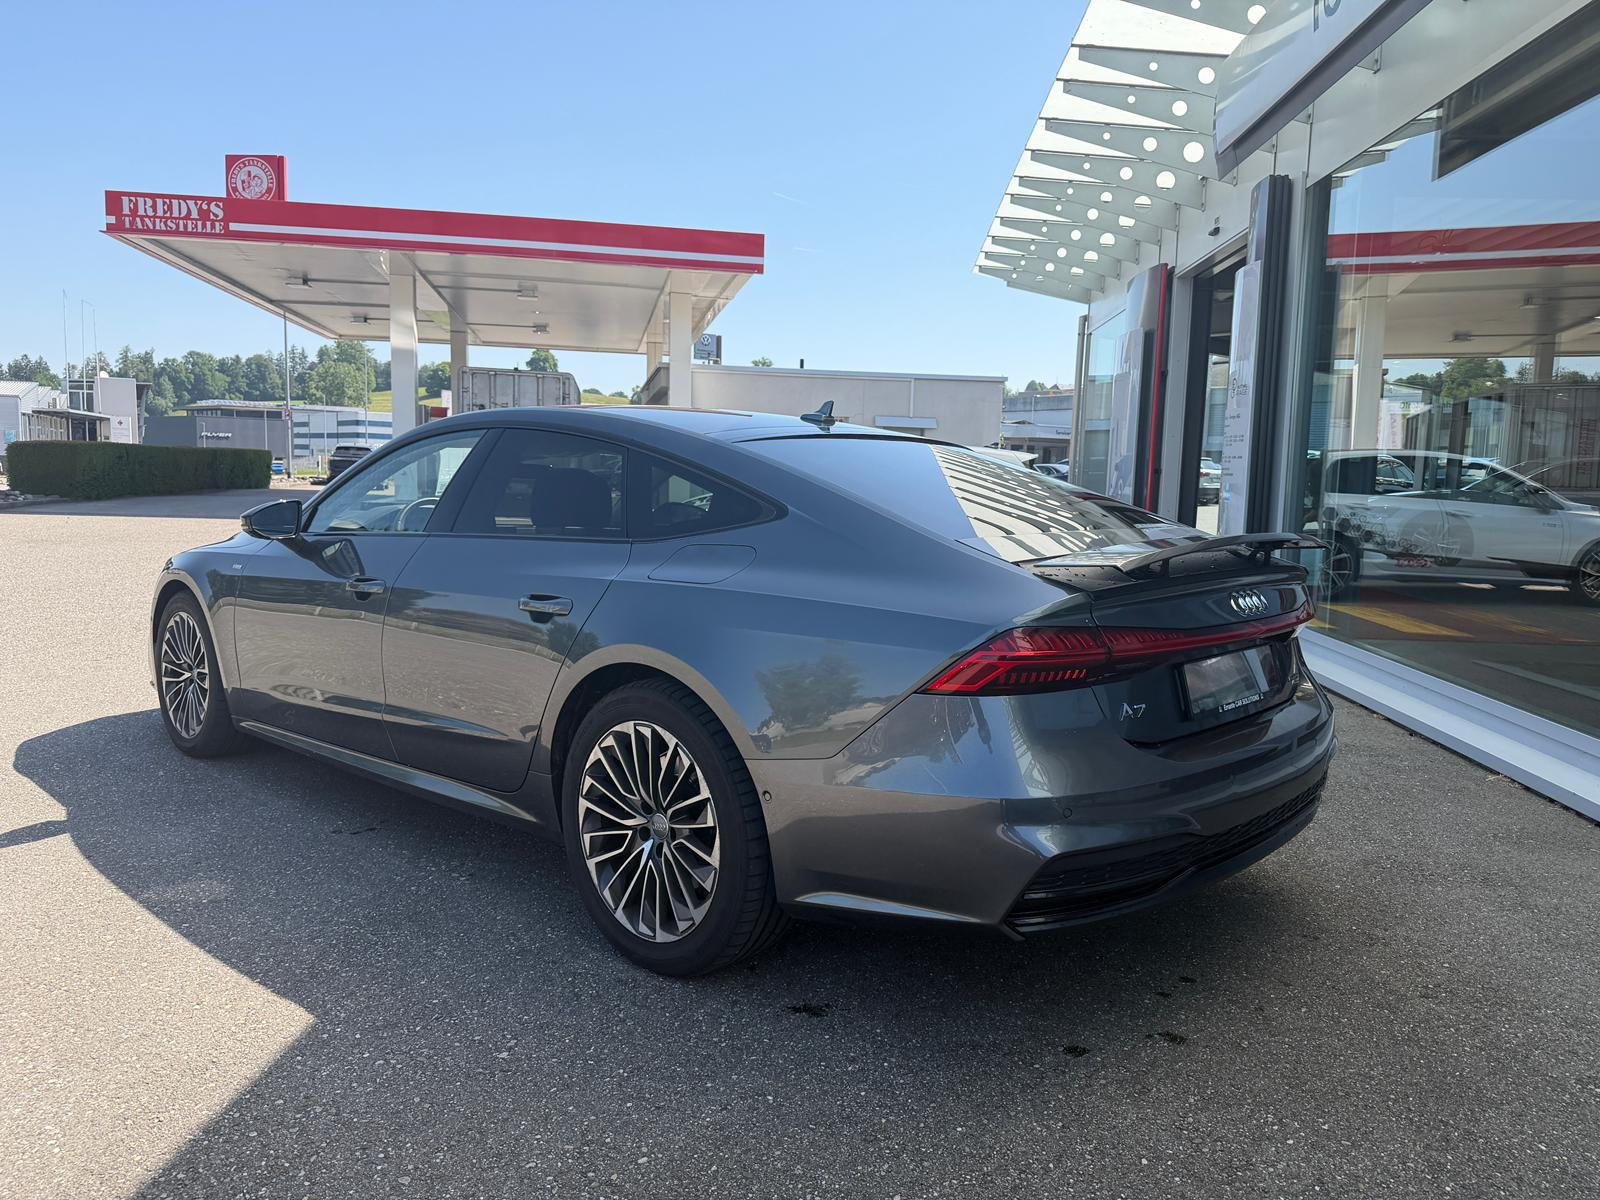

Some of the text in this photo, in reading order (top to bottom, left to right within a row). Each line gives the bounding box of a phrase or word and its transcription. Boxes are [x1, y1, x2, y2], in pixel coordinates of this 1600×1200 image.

[121, 196, 224, 220] FREDY'S
[122, 216, 224, 234] TANKSTELLE
[1120, 702, 1146, 721] A7
